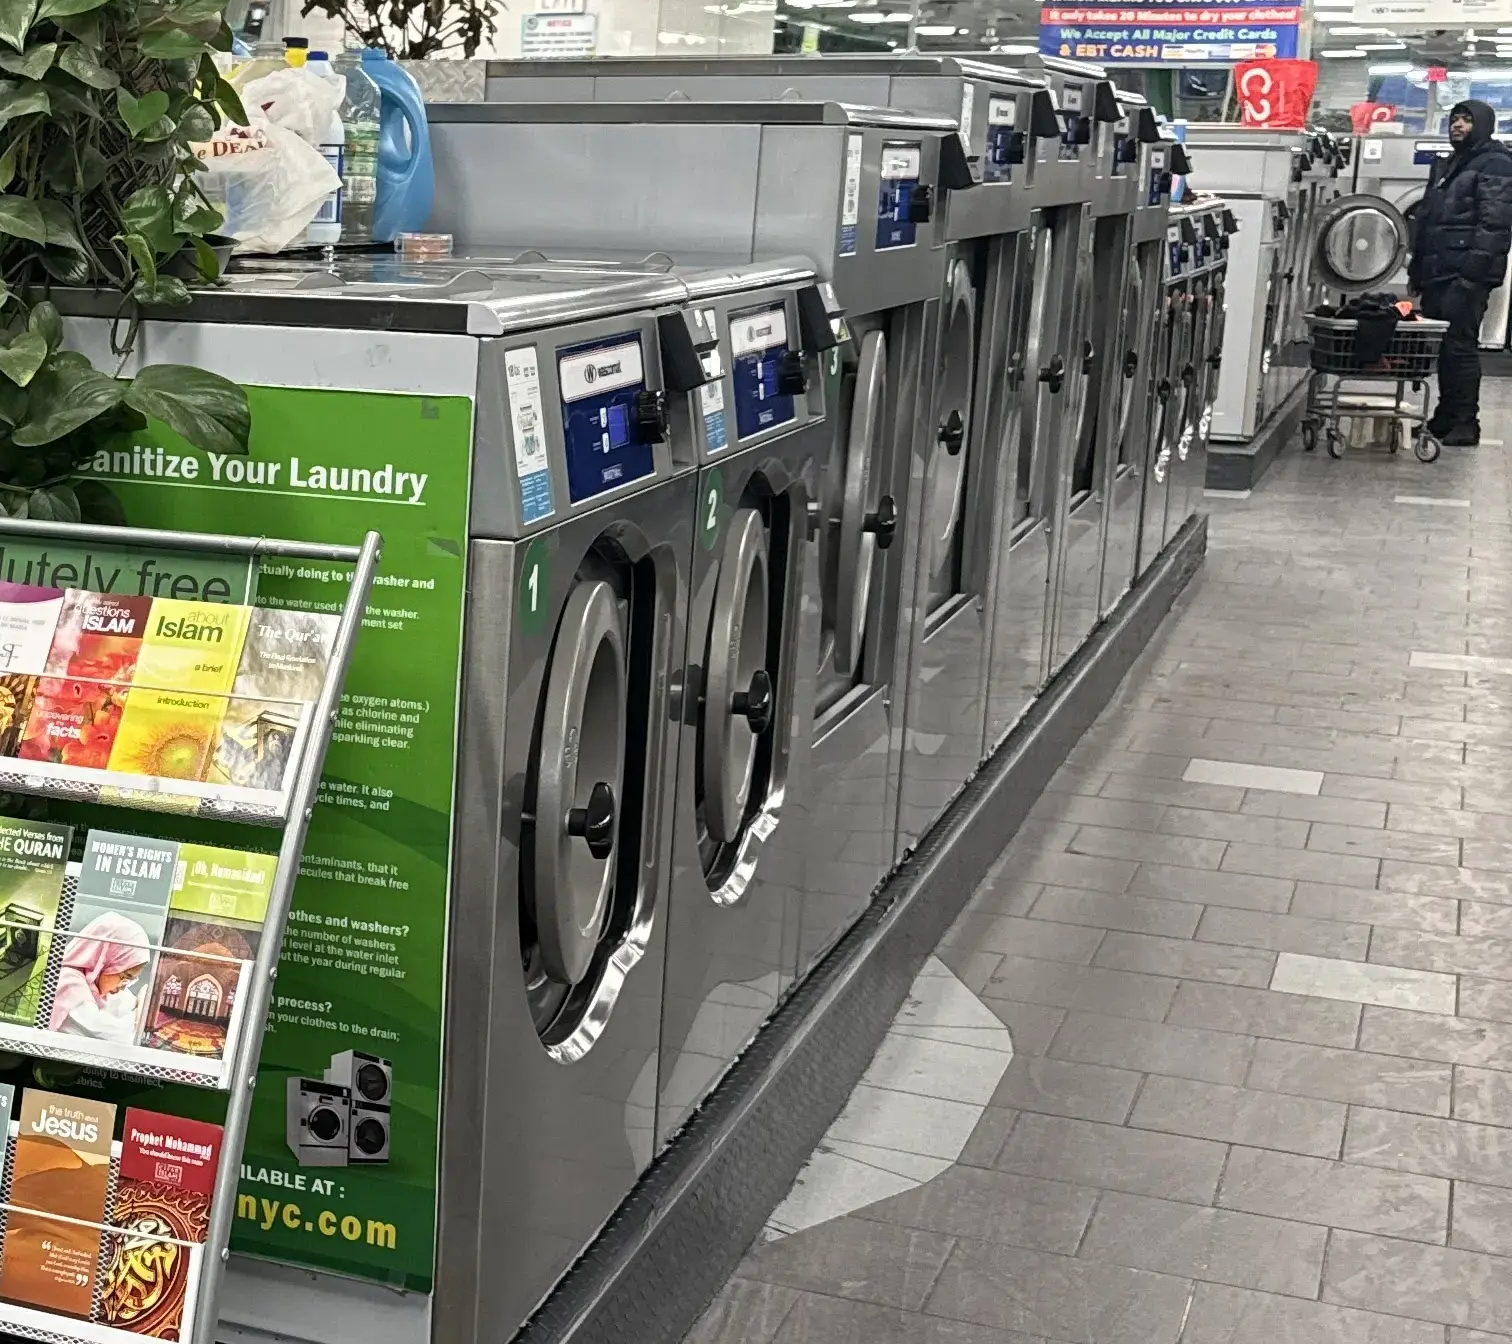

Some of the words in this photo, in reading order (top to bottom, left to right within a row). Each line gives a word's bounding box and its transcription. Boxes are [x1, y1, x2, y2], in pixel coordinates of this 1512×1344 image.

[1184, 10, 1198, 21] to
[1060, 28, 1081, 39] We
[1084, 28, 1129, 43] Accept
[1132, 29, 1150, 40] All
[1153, 29, 1191, 43] Major
[1193, 28, 1235, 40] Credit
[1237, 27, 1277, 40] Cards
[1076, 44, 1107, 57] EBT
[1110, 44, 1159, 57] CASH
[207, 452, 281, 486] Your
[290, 456, 427, 502] Laundry
[707, 489, 717, 529] 2
[137, 560, 231, 603] free
[296, 567, 329, 582] doing
[331, 570, 343, 582] to
[411, 576, 435, 590] and
[528, 564, 539, 612] 1
[75, 604, 131, 620] questions
[286, 598, 312, 609] water
[314, 601, 338, 612] used
[365, 606, 380, 616] the
[82, 615, 136, 634] ISLAM
[188, 610, 231, 625] about
[388, 620, 404, 630] set
[155, 615, 224, 644] Islam
[258, 624, 282, 639] The
[202, 663, 223, 674] brief
[157, 696, 210, 710] introduction
[352, 696, 388, 710] oxygen
[390, 698, 430, 713] atoms.)
[341, 707, 354, 718] as
[356, 707, 398, 722] chlorine
[400, 712, 420, 724] and
[355, 721, 414, 739] eliminating
[332, 732, 380, 748] sparkling
[371, 786, 393, 798] also
[369, 800, 390, 811] and
[13, 839, 64, 860] QURAN
[136, 848, 172, 863] RIGHTS
[95, 854, 111, 873] IN
[116, 859, 162, 880] ISLAM
[368, 862, 388, 875] that
[391, 864, 398, 876] it
[335, 870, 356, 883] that
[358, 874, 387, 888] break
[388, 877, 409, 890] free
[325, 915, 348, 928] and
[350, 919, 410, 938] washers?
[300, 928, 339, 943] number
[341, 934, 352, 945] of
[353, 937, 396, 952] washers
[327, 945, 344, 956] the
[345, 949, 373, 961] water
[375, 952, 399, 965] inlet
[293, 952, 309, 964] the
[310, 956, 332, 968] year
[334, 959, 368, 975] during
[369, 965, 406, 979] regular
[277, 995, 332, 1014] process?
[277, 1012, 299, 1024] your
[300, 1015, 337, 1030] clothes
[339, 1021, 350, 1032] to
[351, 1024, 368, 1036] the
[50, 1104, 63, 1117] the
[31, 1109, 98, 1143] Jesus
[130, 1128, 164, 1147] Prophet
[311, 1178, 335, 1196] AT
